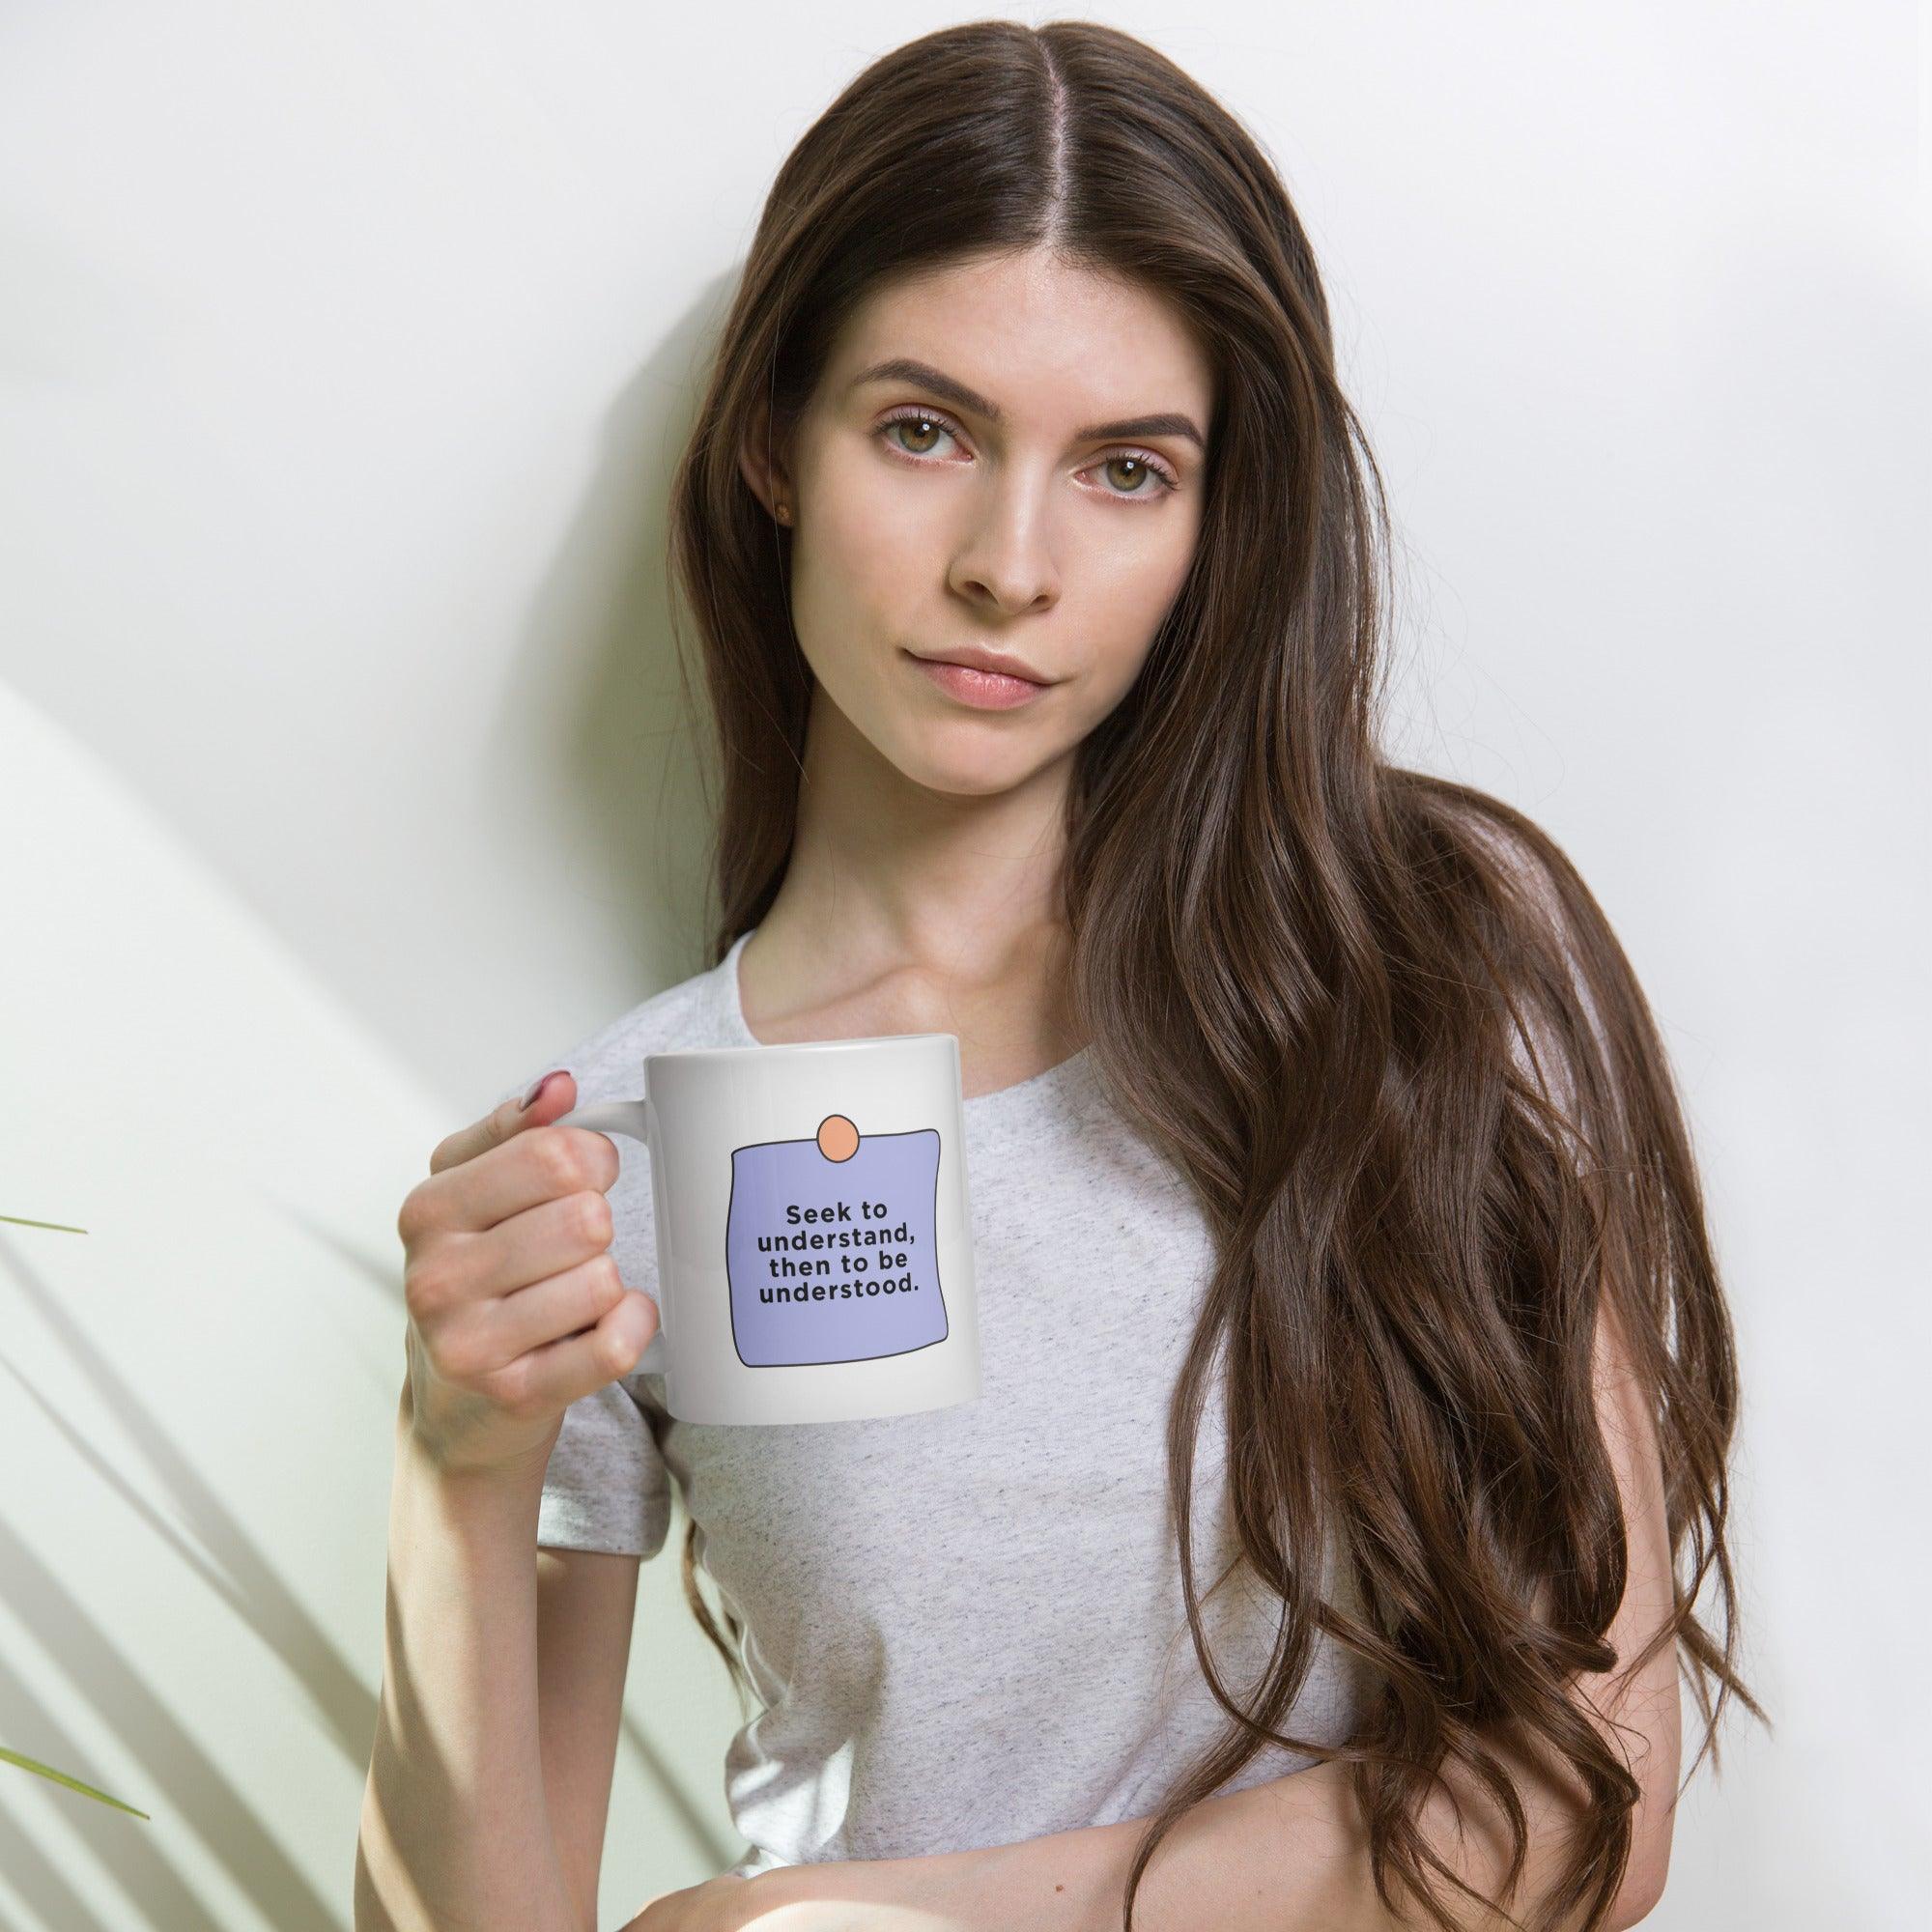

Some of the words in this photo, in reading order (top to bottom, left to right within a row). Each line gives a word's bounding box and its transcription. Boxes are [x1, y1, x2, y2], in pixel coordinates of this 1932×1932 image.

[785, 1201, 852, 1225] Seek
[861, 1201, 888, 1220] to
[757, 1221, 916, 1253] understand,
[769, 1255, 831, 1278] then
[840, 1255, 868, 1274] to
[878, 1250, 908, 1270] be
[759, 1271, 920, 1304] understood.
